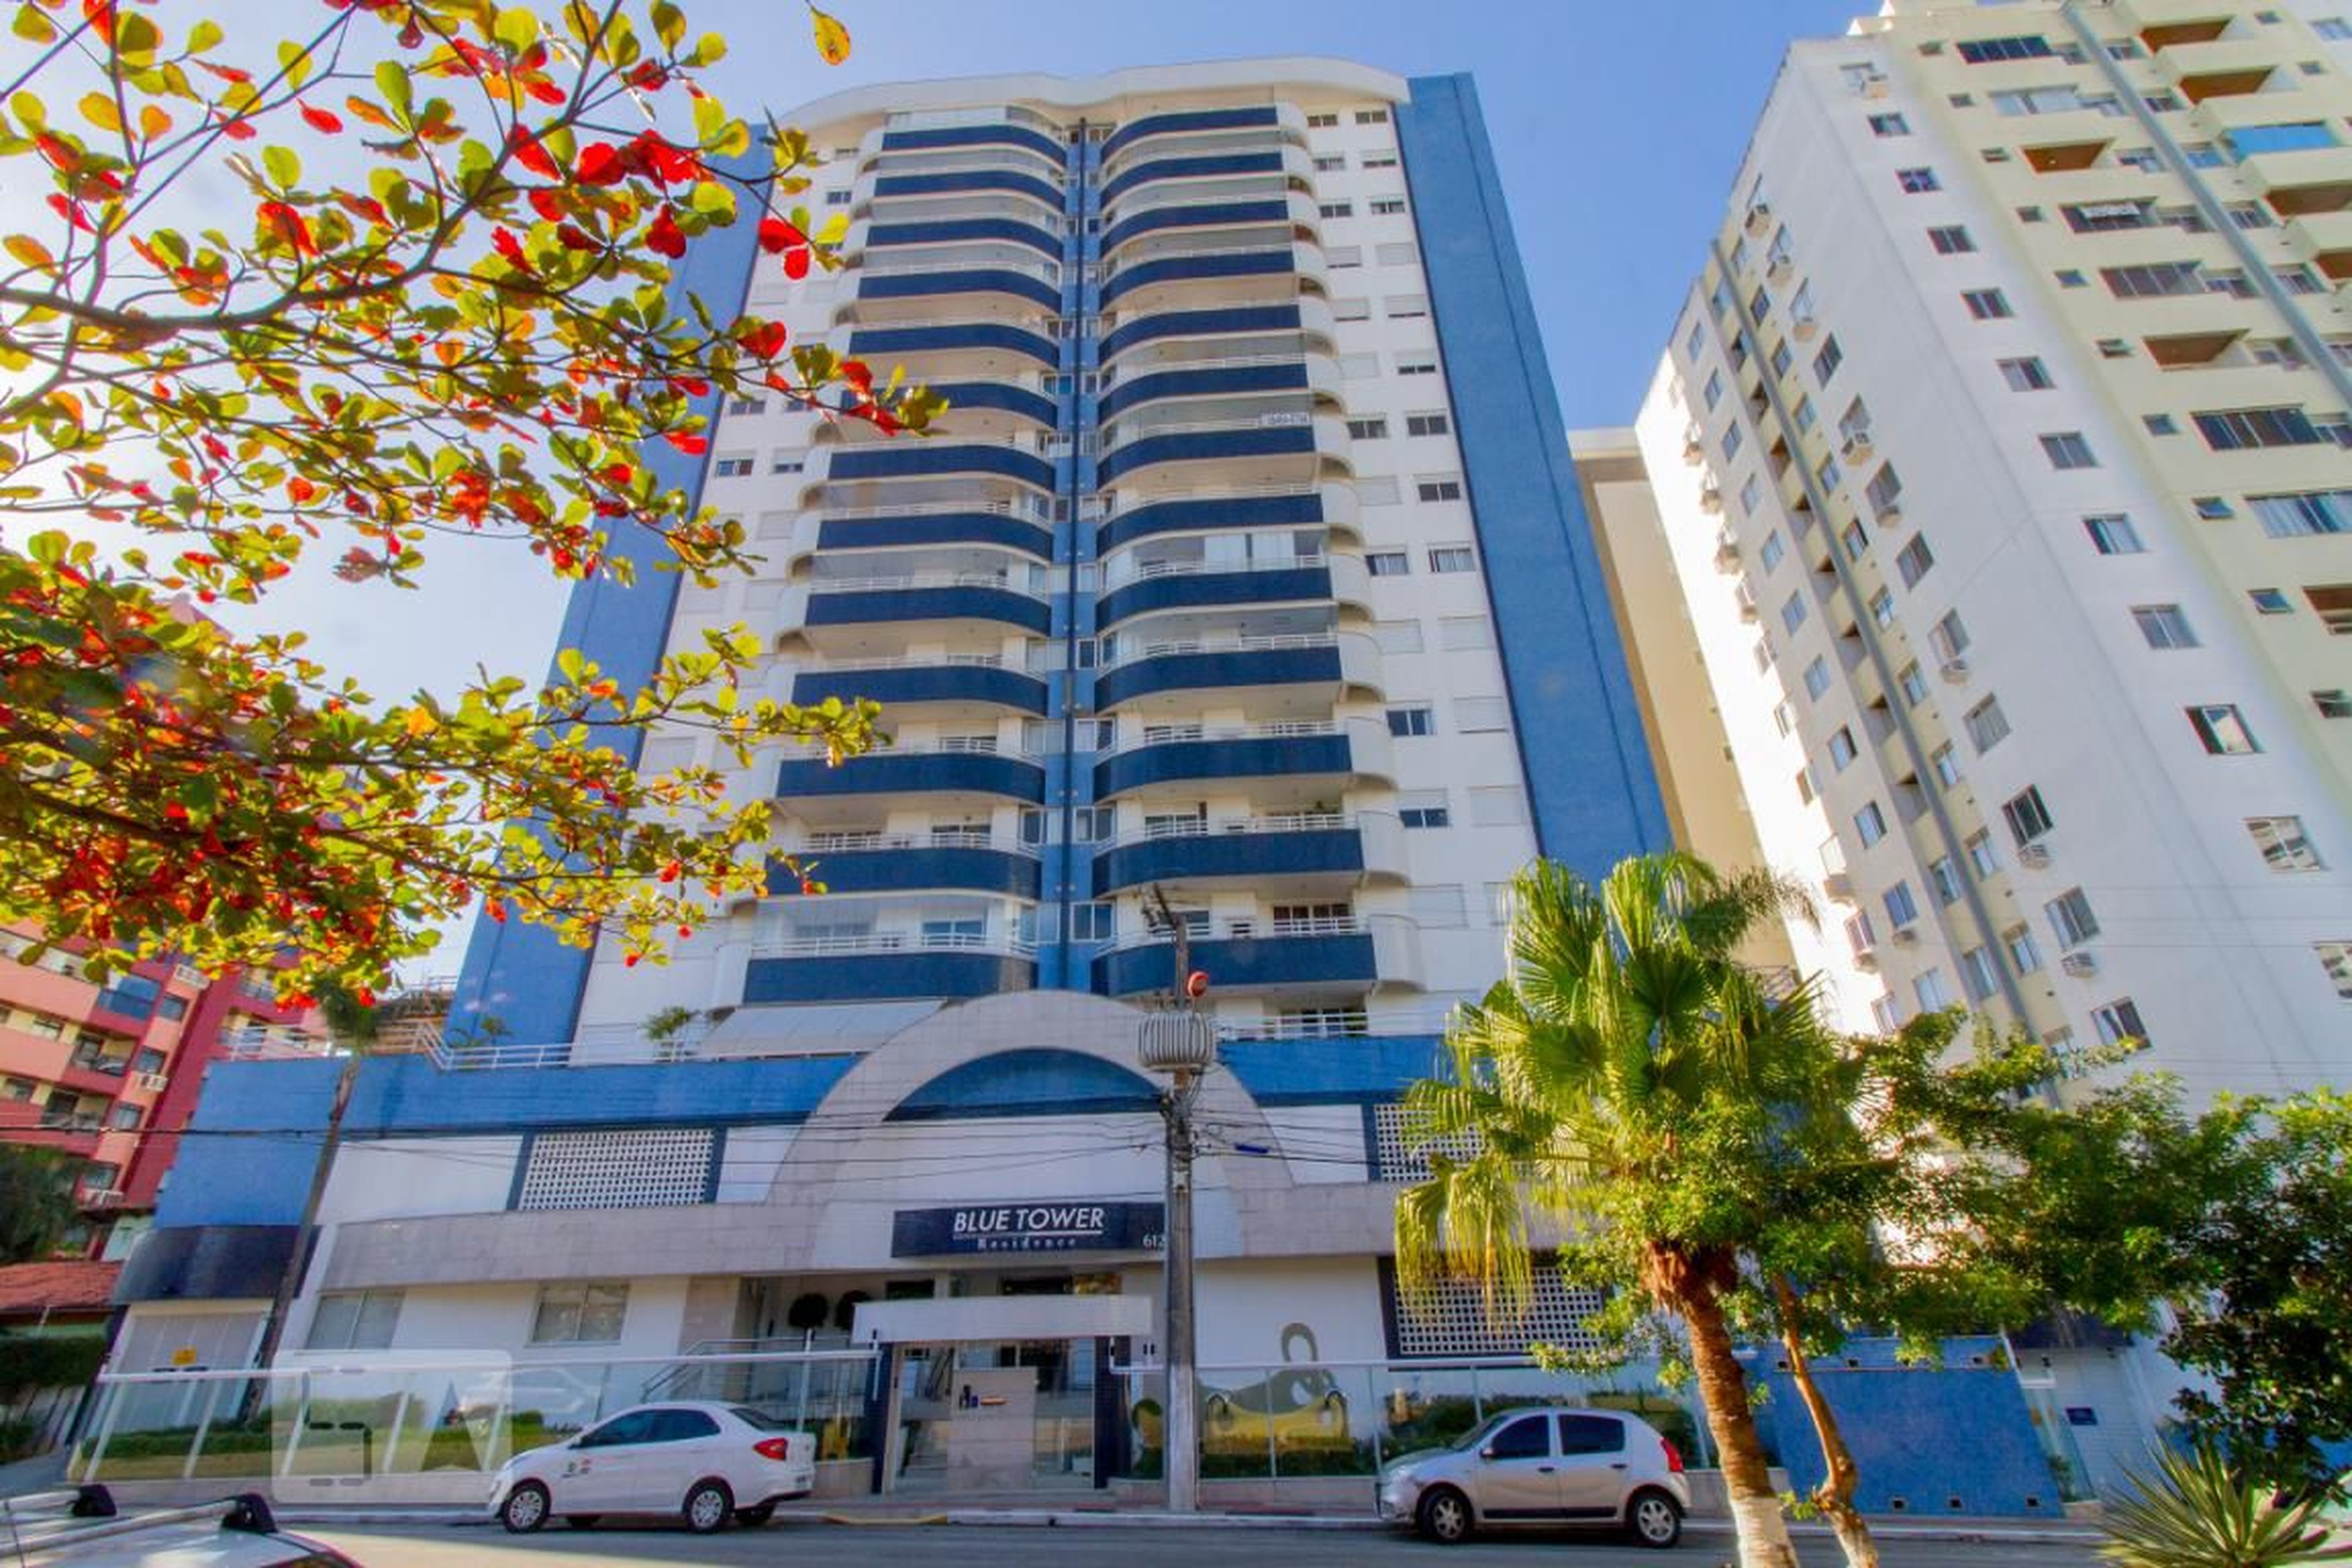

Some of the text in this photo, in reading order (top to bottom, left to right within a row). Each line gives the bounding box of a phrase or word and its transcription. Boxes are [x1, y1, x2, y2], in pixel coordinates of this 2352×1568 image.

[954, 1207, 1104, 1232] BLUE TOWER
[977, 1237, 1077, 1250] Residence
